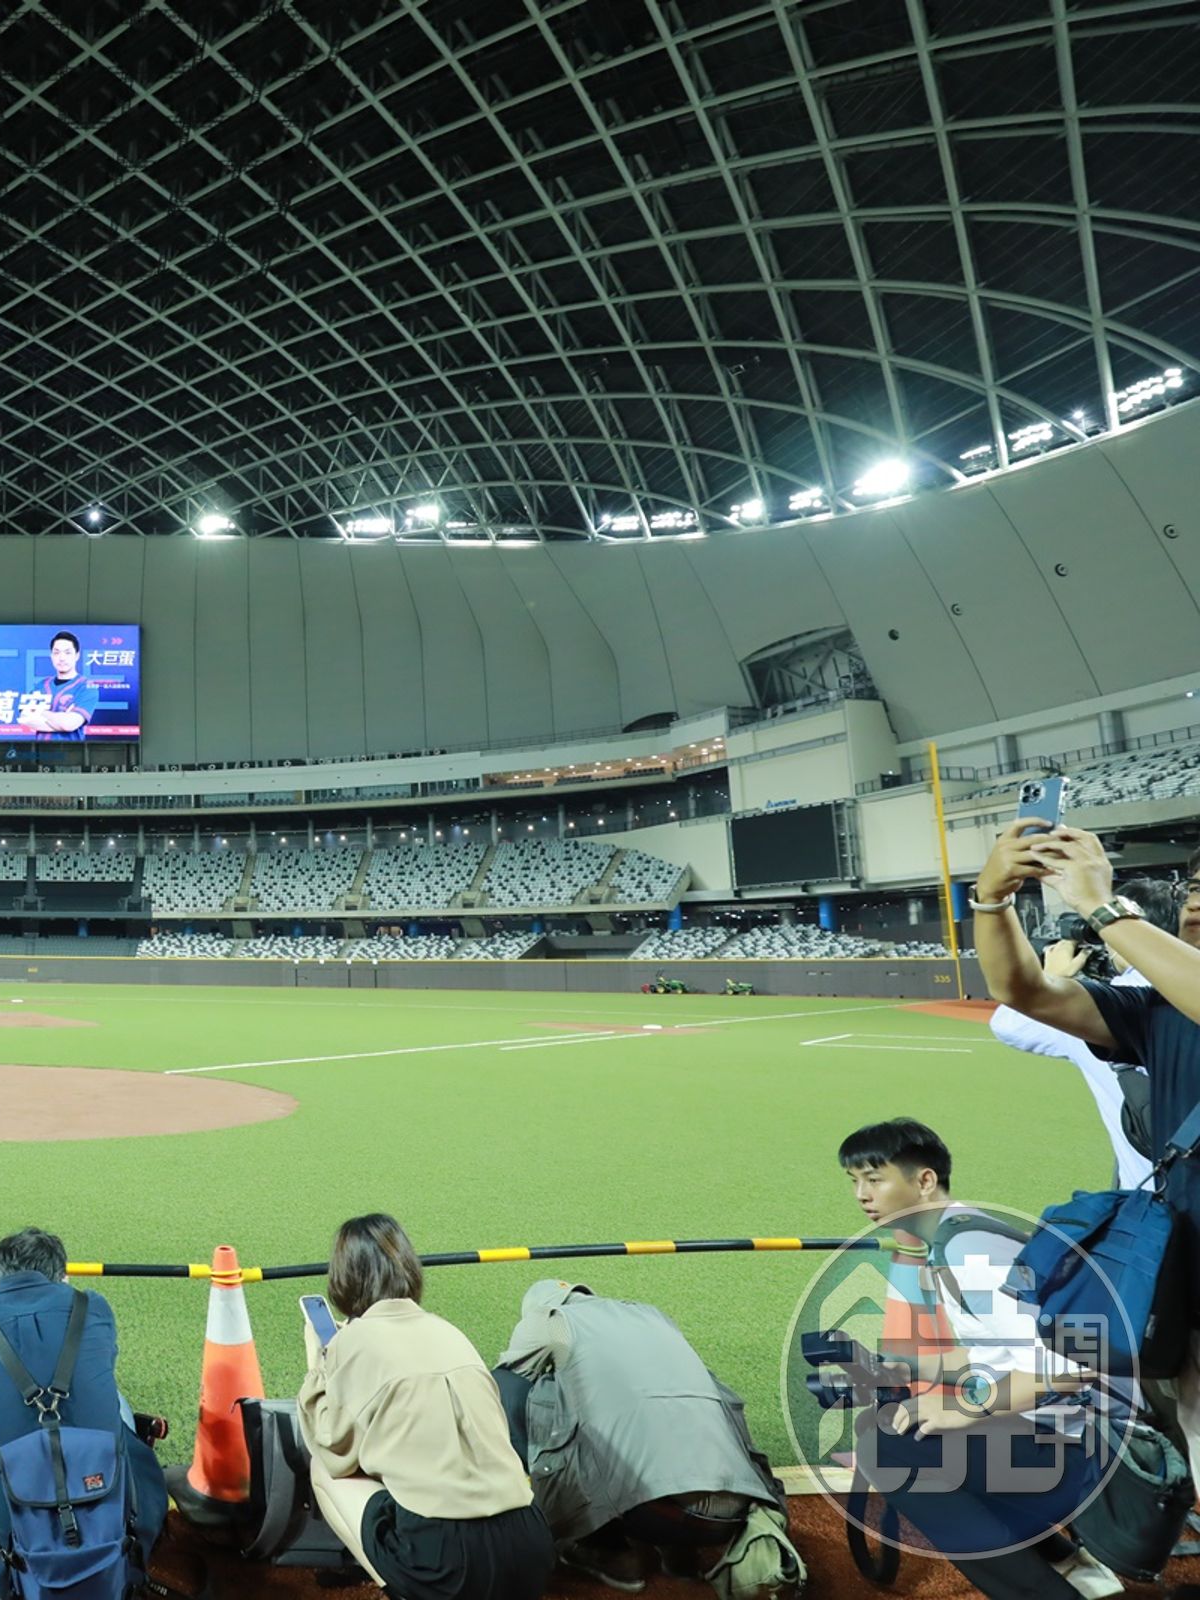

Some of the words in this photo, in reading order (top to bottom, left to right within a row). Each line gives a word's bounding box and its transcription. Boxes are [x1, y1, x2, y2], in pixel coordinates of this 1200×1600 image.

[85, 650, 136, 667] 大巨蛋
[933, 975, 951, 984] 335
